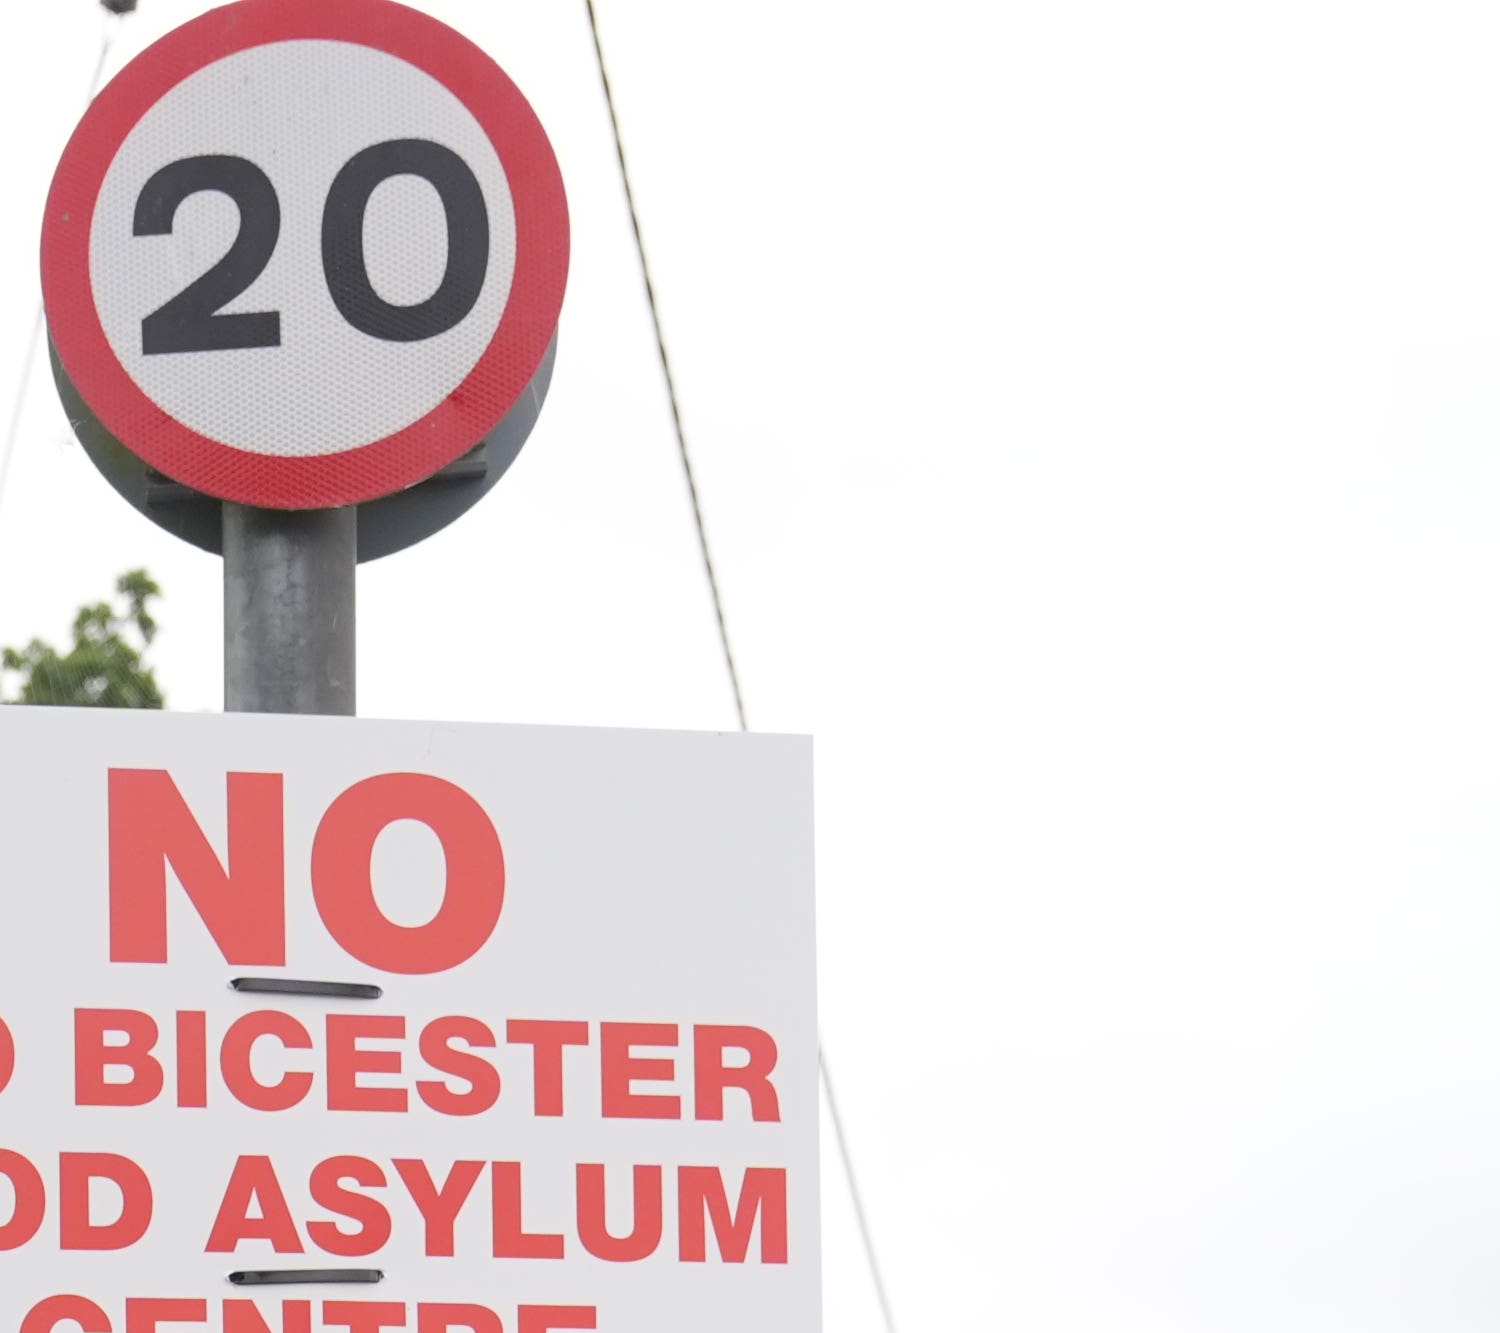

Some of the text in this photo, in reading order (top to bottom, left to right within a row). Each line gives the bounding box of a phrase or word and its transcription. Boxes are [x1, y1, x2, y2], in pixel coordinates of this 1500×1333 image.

[134, 139, 489, 354] 20
[109, 769, 505, 974] NO
[75, 1009, 780, 1121] BICESTER
[206, 1155, 787, 1263] ASYLUM
